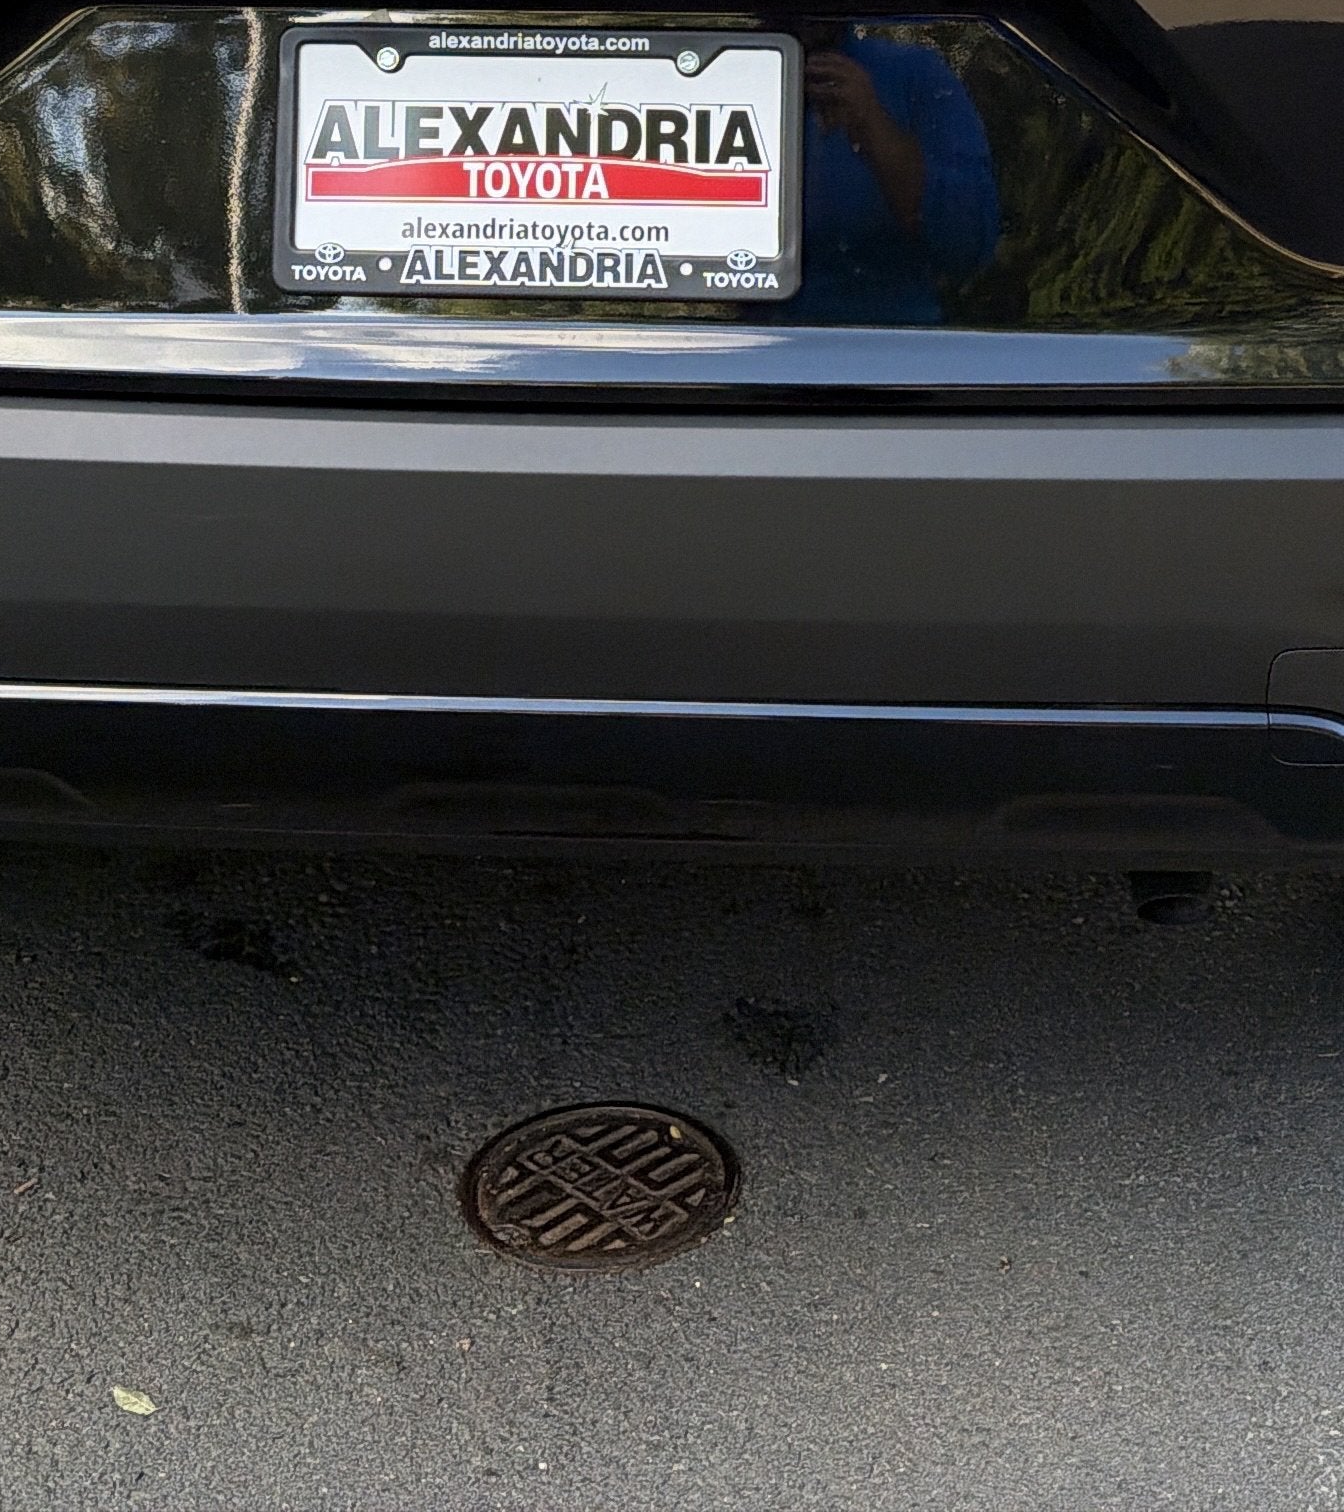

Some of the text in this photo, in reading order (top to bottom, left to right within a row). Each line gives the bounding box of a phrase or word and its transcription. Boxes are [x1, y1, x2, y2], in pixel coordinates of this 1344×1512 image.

[428, 32, 650, 55] alexandriatoyota.com
[309, 103, 765, 166] ALEXANDRIA
[462, 161, 610, 200] TOYOTA
[400, 216, 670, 248] alexandriatoyota.com
[291, 263, 367, 282] TOYOTA
[402, 247, 666, 287] ALEXANDRIA
[702, 271, 780, 289] TOYOTA
